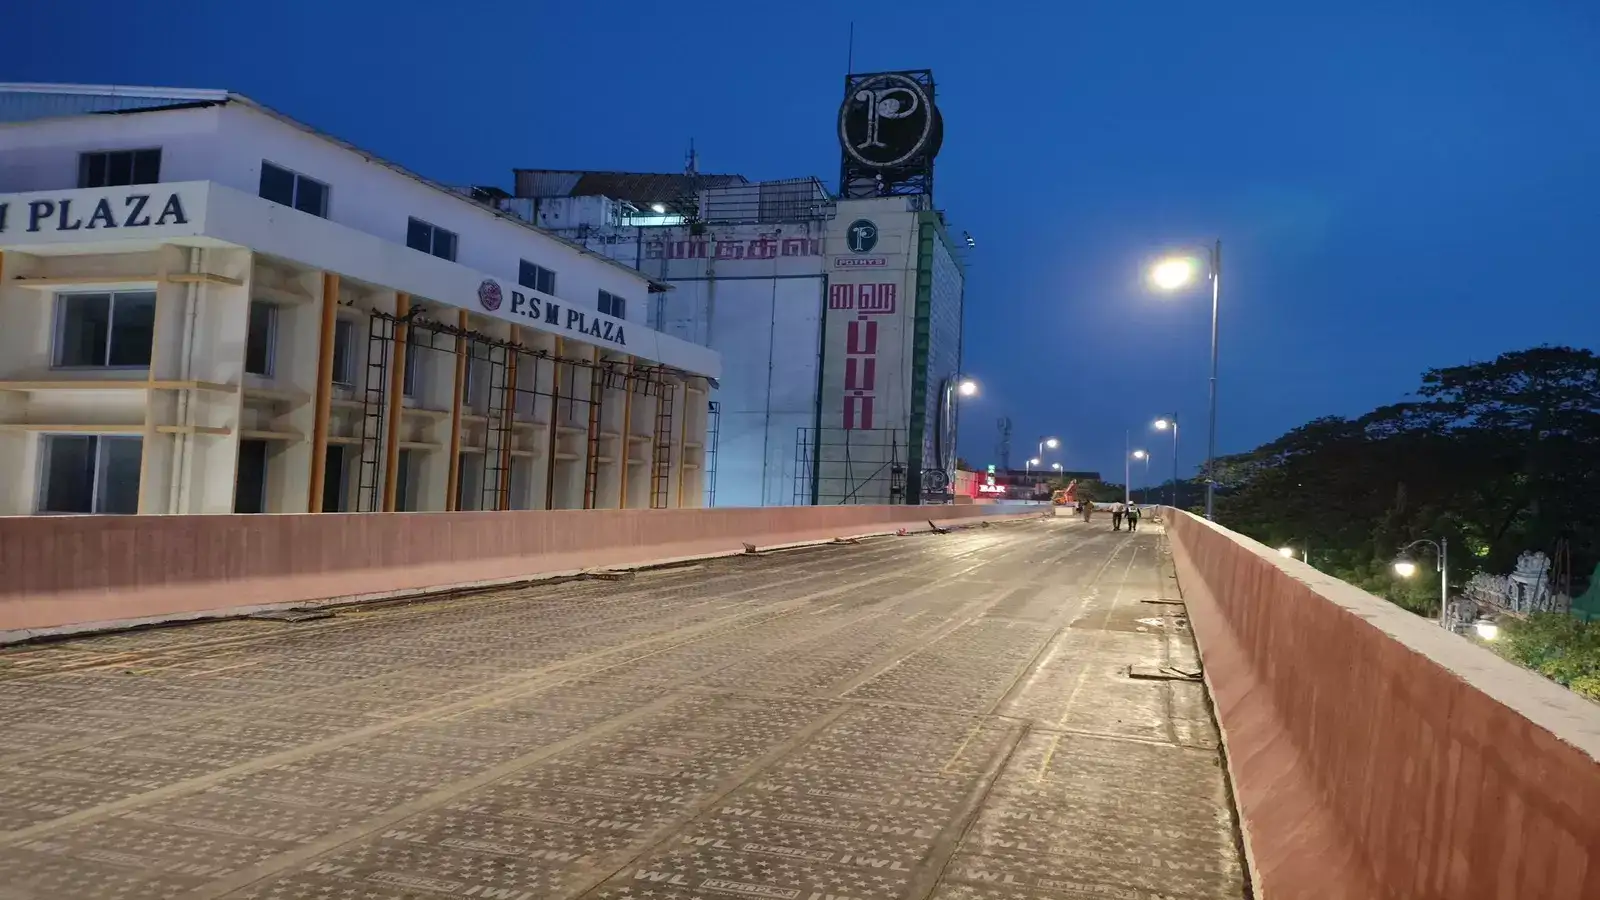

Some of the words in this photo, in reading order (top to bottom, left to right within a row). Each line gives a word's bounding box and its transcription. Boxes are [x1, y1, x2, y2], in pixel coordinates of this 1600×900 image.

[26, 192, 188, 232] PLAZA
[566, 308, 626, 346] PLAZA
[979, 484, 1006, 493] BAR
